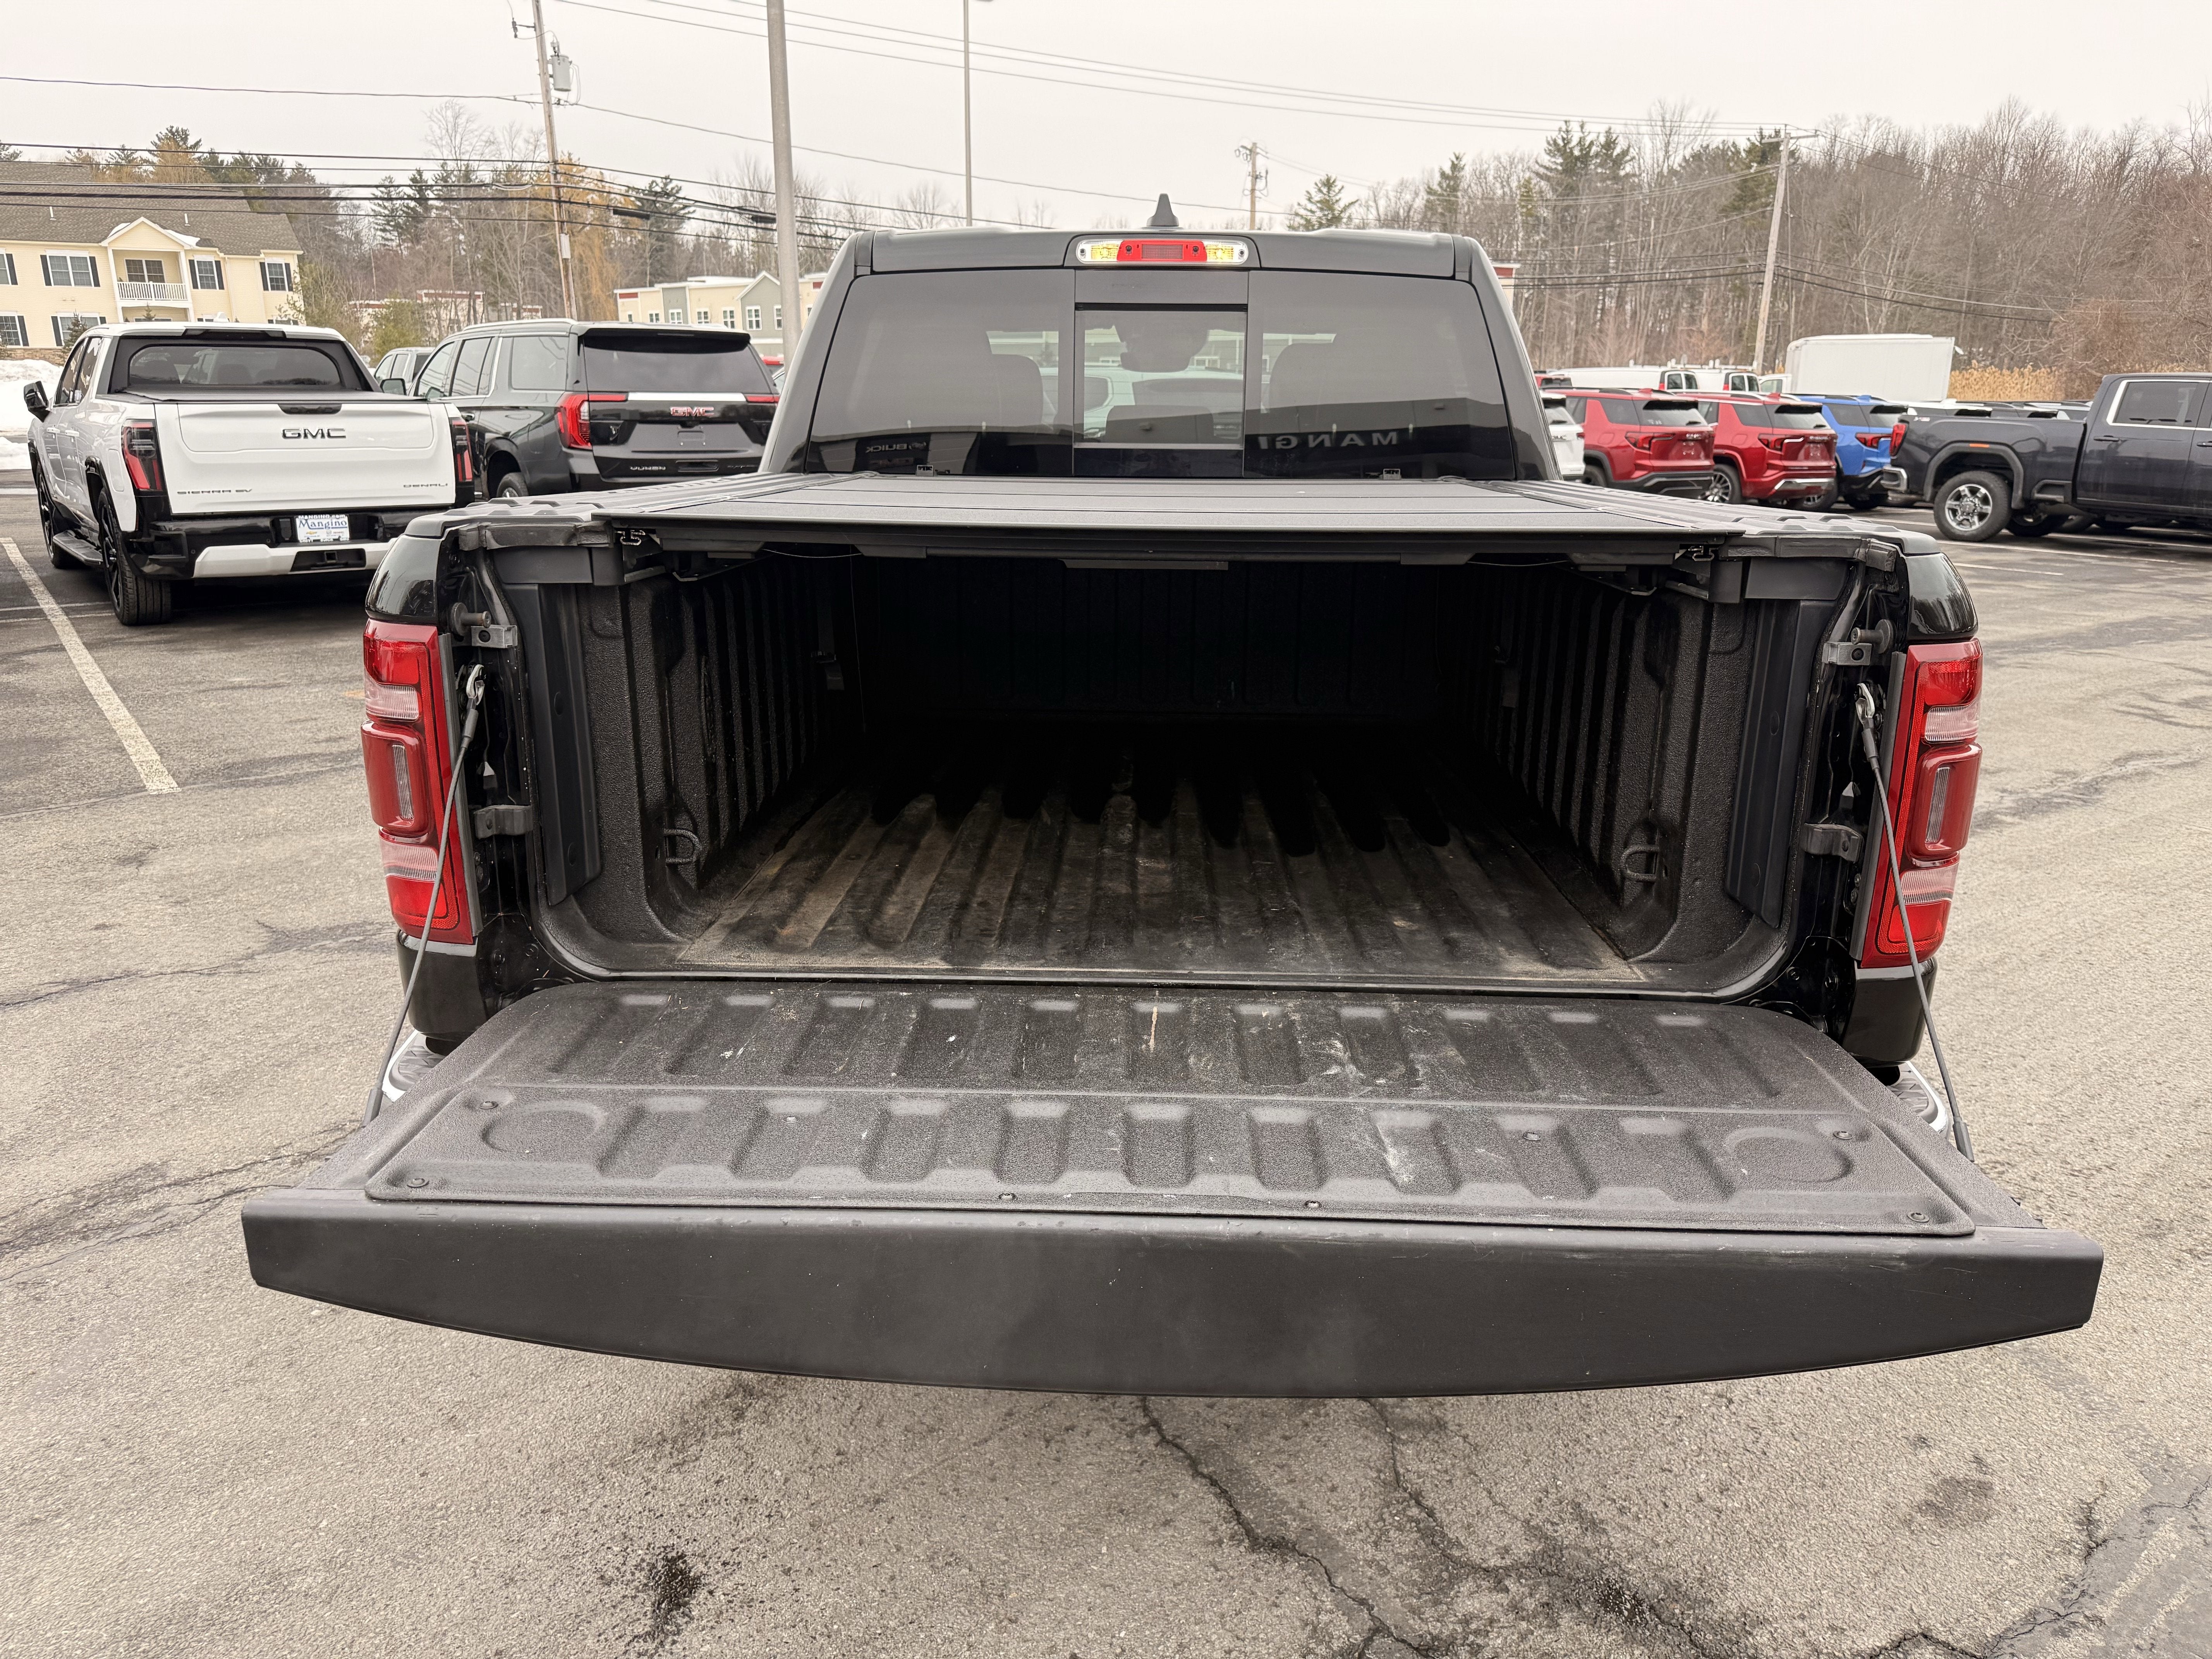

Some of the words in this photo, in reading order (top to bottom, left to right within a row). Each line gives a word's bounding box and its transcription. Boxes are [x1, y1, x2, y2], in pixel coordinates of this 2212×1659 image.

[670, 407, 714, 417] GMC
[282, 428, 346, 439] GMC
[299, 519, 347, 530] Mangino
